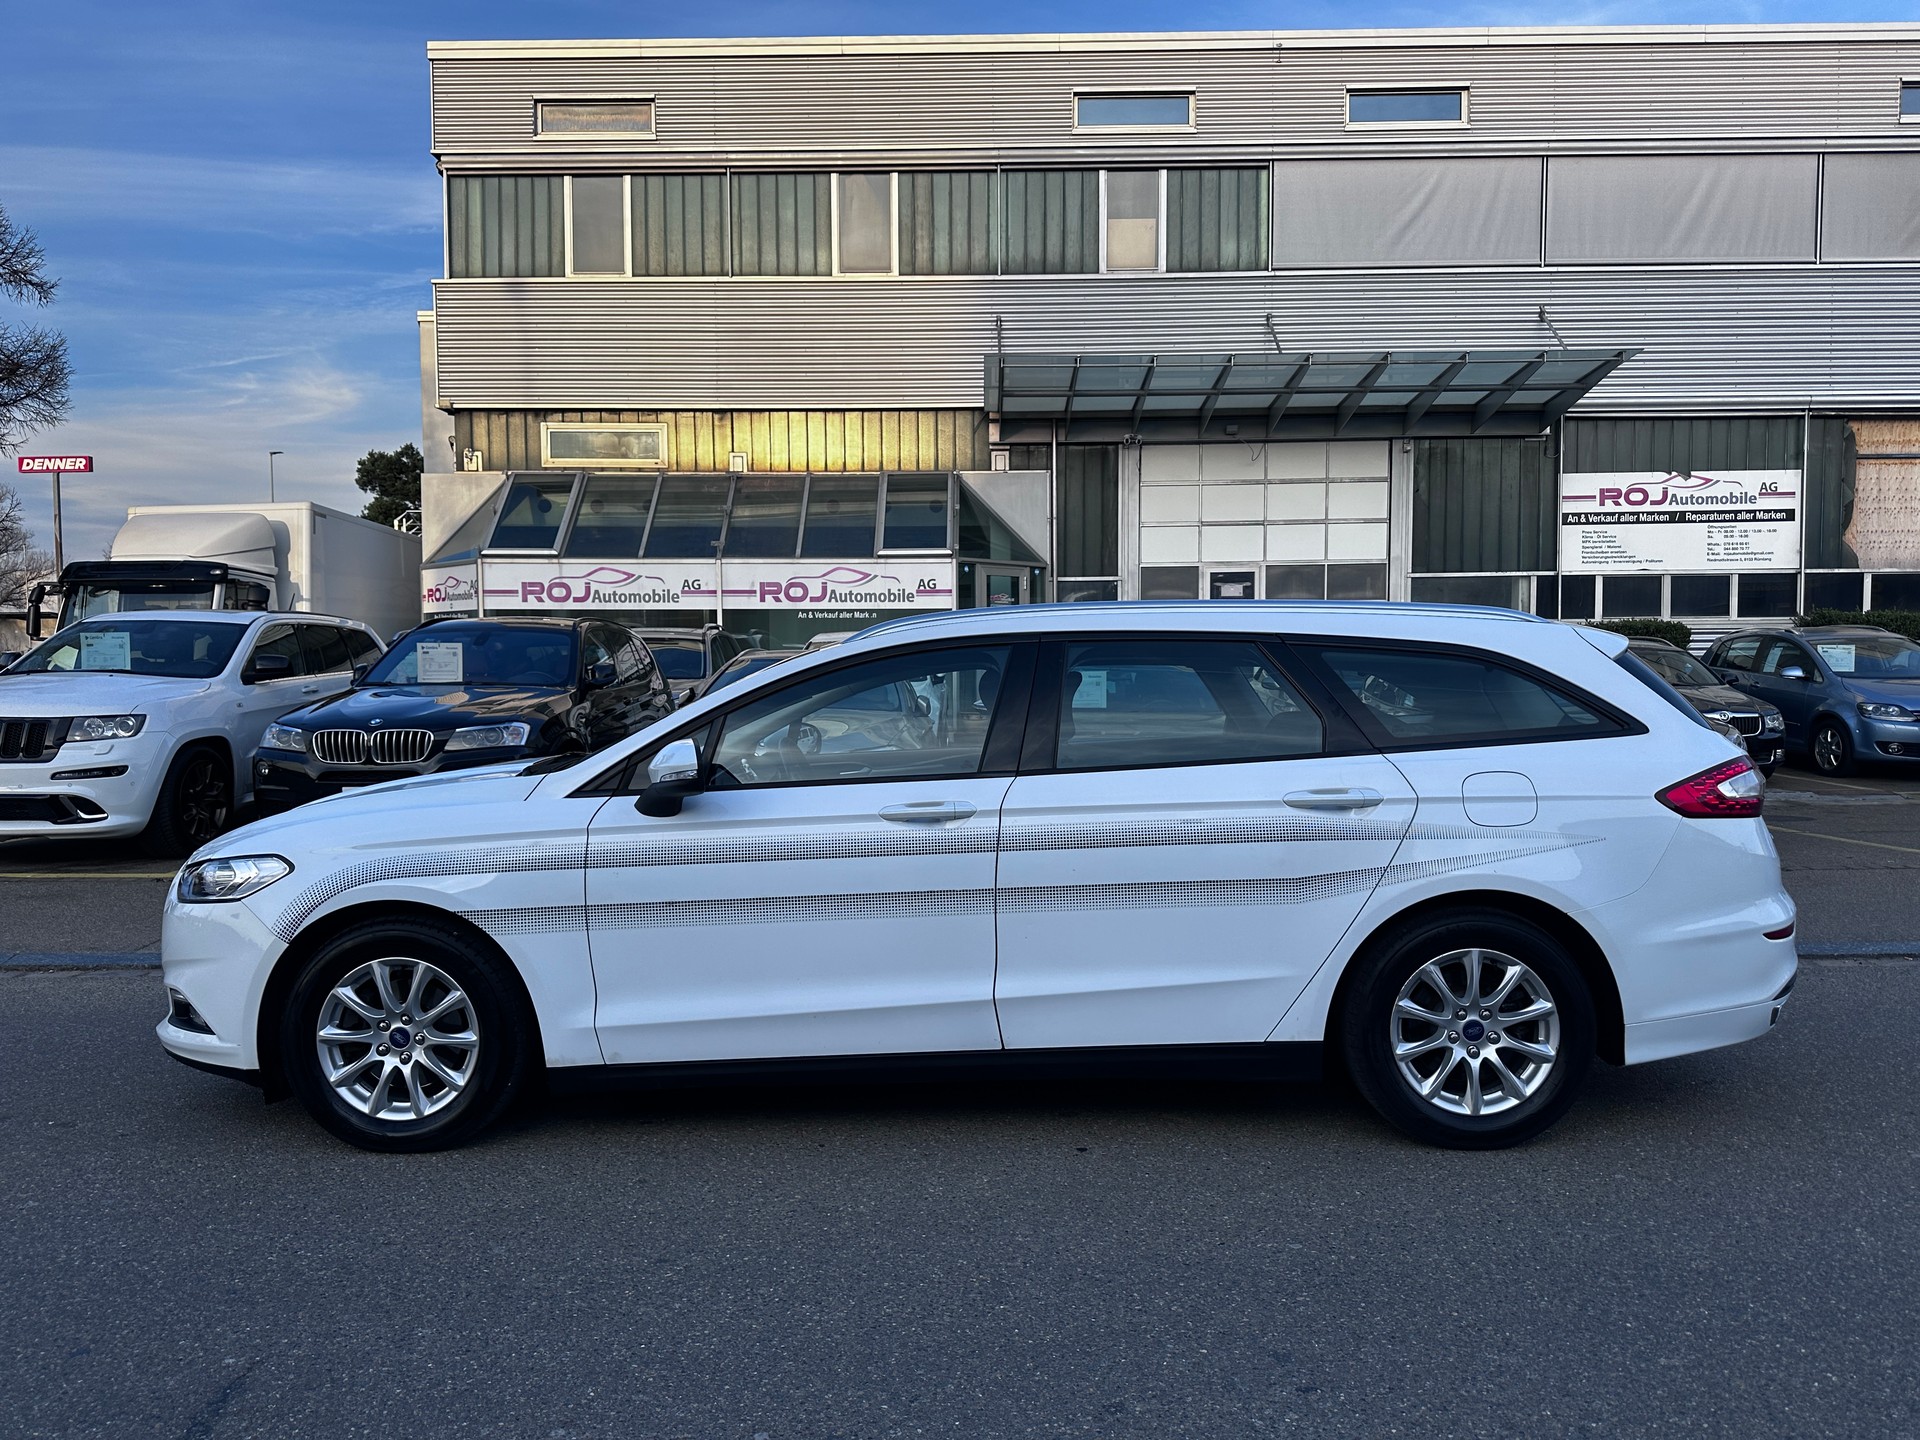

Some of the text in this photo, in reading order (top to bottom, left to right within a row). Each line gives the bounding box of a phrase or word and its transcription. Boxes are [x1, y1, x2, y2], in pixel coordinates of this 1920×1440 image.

[21, 458, 86, 470] DENNER
[1599, 482, 1778, 506] ROJ Automobile AG
[1567, 511, 1786, 523] An & Verkauf aller Marken / Reparaturen aller Marken
[427, 587, 447, 603] ROJ
[447, 590, 473, 601] Automobile
[521, 579, 701, 603] ROJ Automobile AG
[759, 578, 937, 603] ROJ Automobile AG
